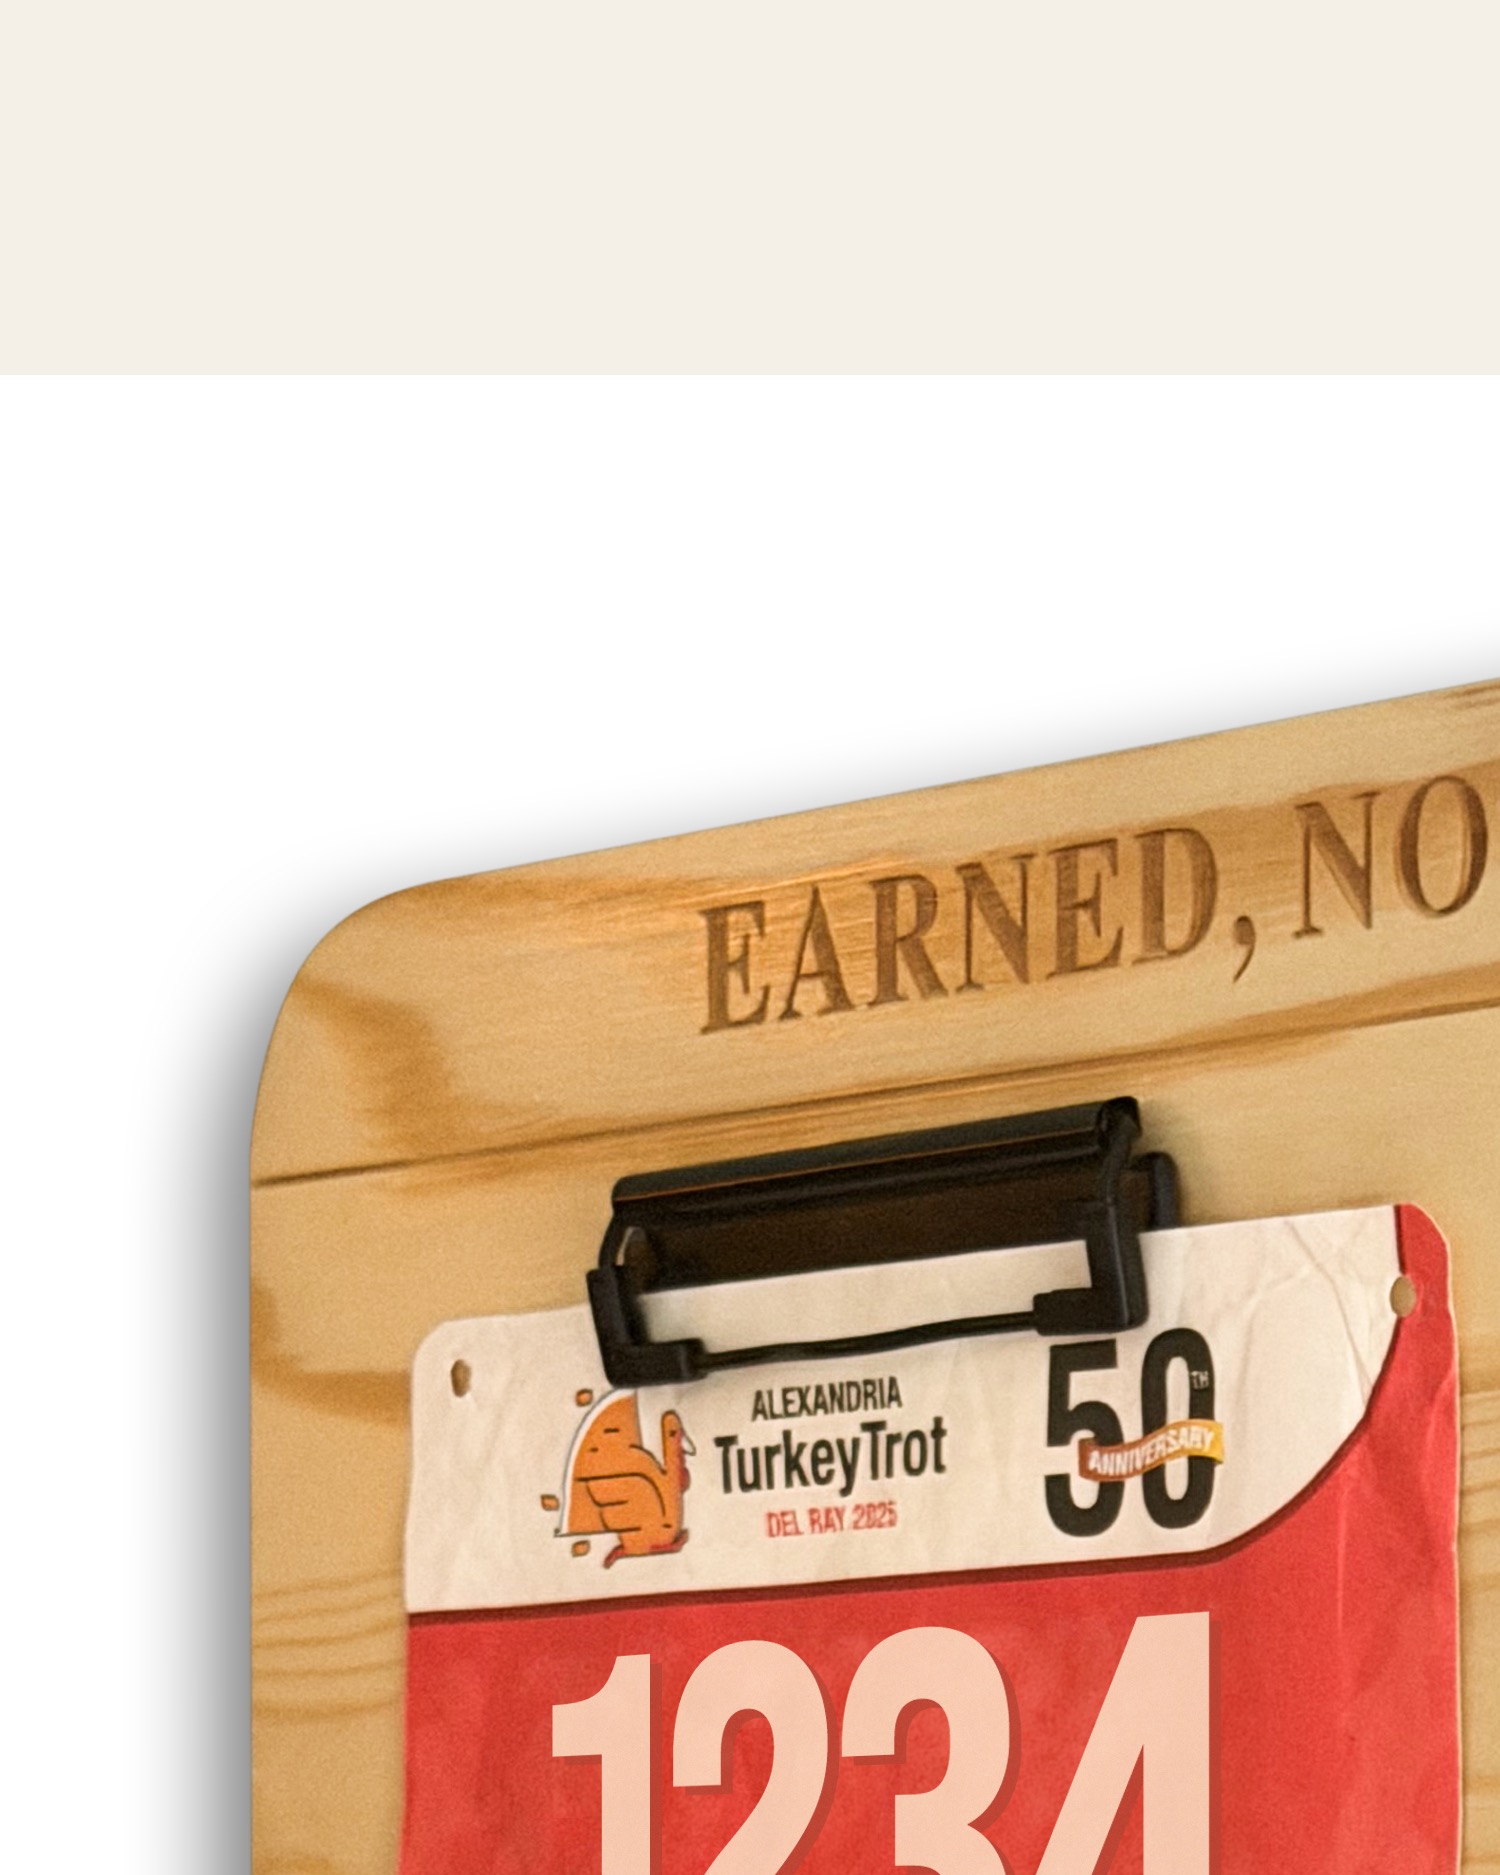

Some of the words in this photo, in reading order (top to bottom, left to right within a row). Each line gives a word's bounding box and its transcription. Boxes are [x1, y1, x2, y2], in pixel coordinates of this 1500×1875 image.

[697, 824, 1258, 1034] EARNED,
[751, 1376, 903, 1422] ALEXANDRIA
[1088, 1425, 1214, 1477] ANNIVERSARY
[766, 1510, 804, 1538] DEL
[807, 1505, 846, 1534] RAY
[852, 1500, 898, 1530] 2025
